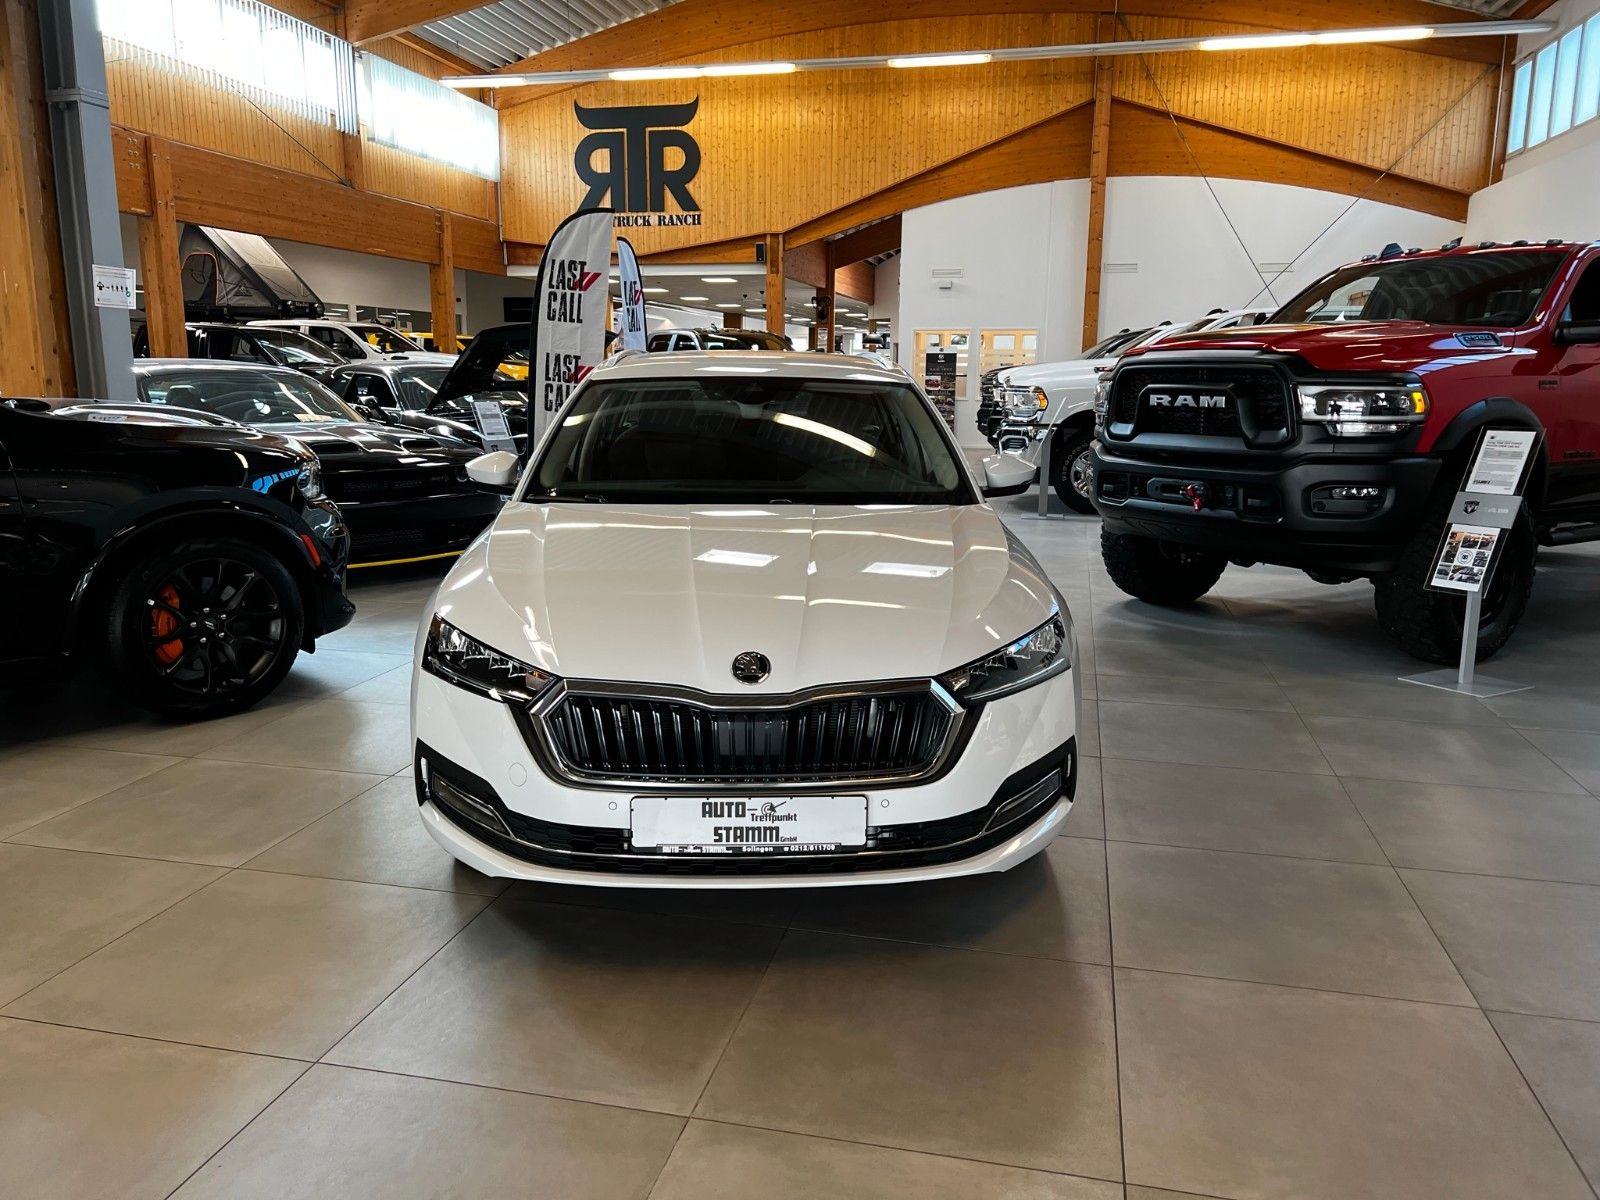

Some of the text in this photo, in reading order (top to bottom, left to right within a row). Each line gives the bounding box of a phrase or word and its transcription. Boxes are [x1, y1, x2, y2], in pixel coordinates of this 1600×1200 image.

[657, 214, 702, 226] RANCH
[548, 259, 587, 291] LAST
[547, 291, 584, 324] CALL
[544, 352, 581, 384] LAST
[1149, 394, 1226, 408] RAM
[750, 812, 798, 824] Treffpunkt
[713, 826, 780, 843] STAMM
